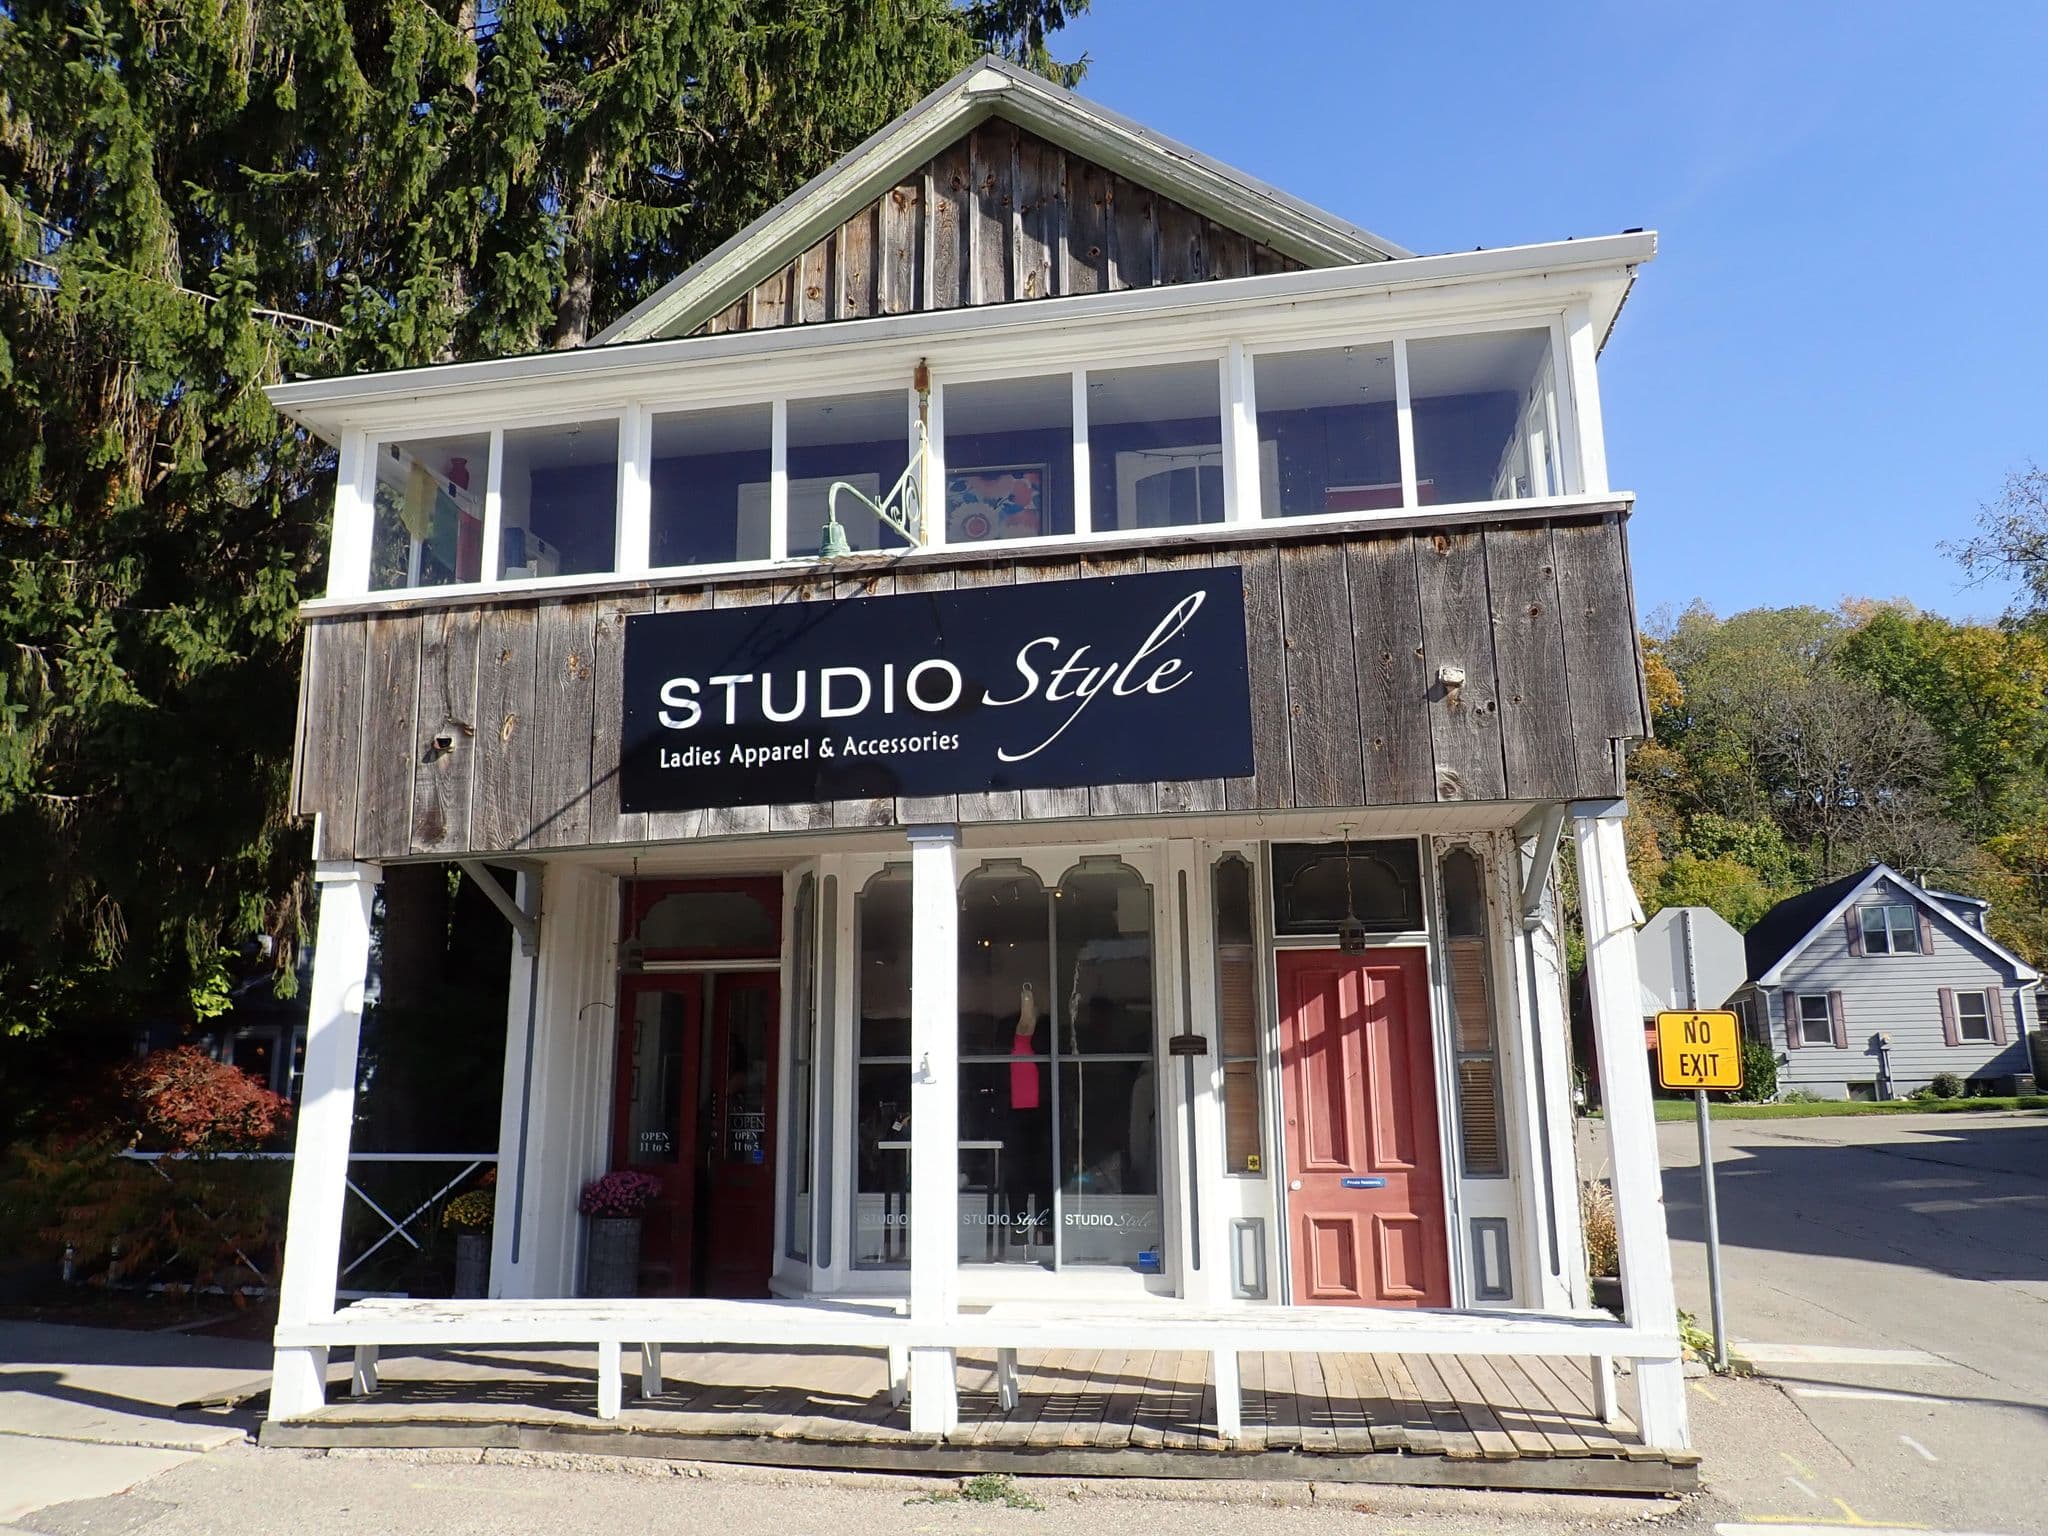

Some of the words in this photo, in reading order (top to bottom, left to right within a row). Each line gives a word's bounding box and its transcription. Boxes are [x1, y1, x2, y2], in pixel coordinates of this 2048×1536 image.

[658, 658, 963, 730] STUDIO
[981, 590, 1207, 762] Style
[660, 746, 721, 769] Ladies
[729, 738, 809, 769] Apparel
[818, 737, 835, 759] &
[842, 730, 959, 757] Accessories
[1684, 1020, 1711, 1043] NO
[1679, 1053, 1719, 1077] EXIT
[733, 1116, 766, 1129] OPEN
[640, 1131, 669, 1141] OPEN
[734, 1131, 758, 1141] OPEN
[640, 1141, 649, 1152] 11
[652, 1143, 662, 1152] to
[664, 1142, 671, 1152] 5
[734, 1141, 742, 1151] 11
[744, 1143, 753, 1152] to
[753, 1142, 759, 1151] 5
[862, 1213, 909, 1225] STUDIO
[962, 1214, 1010, 1225] STUDIO
[1010, 1207, 1050, 1234] Style
[1064, 1213, 1114, 1226] STUDIO
[1114, 1209, 1154, 1235] Style
